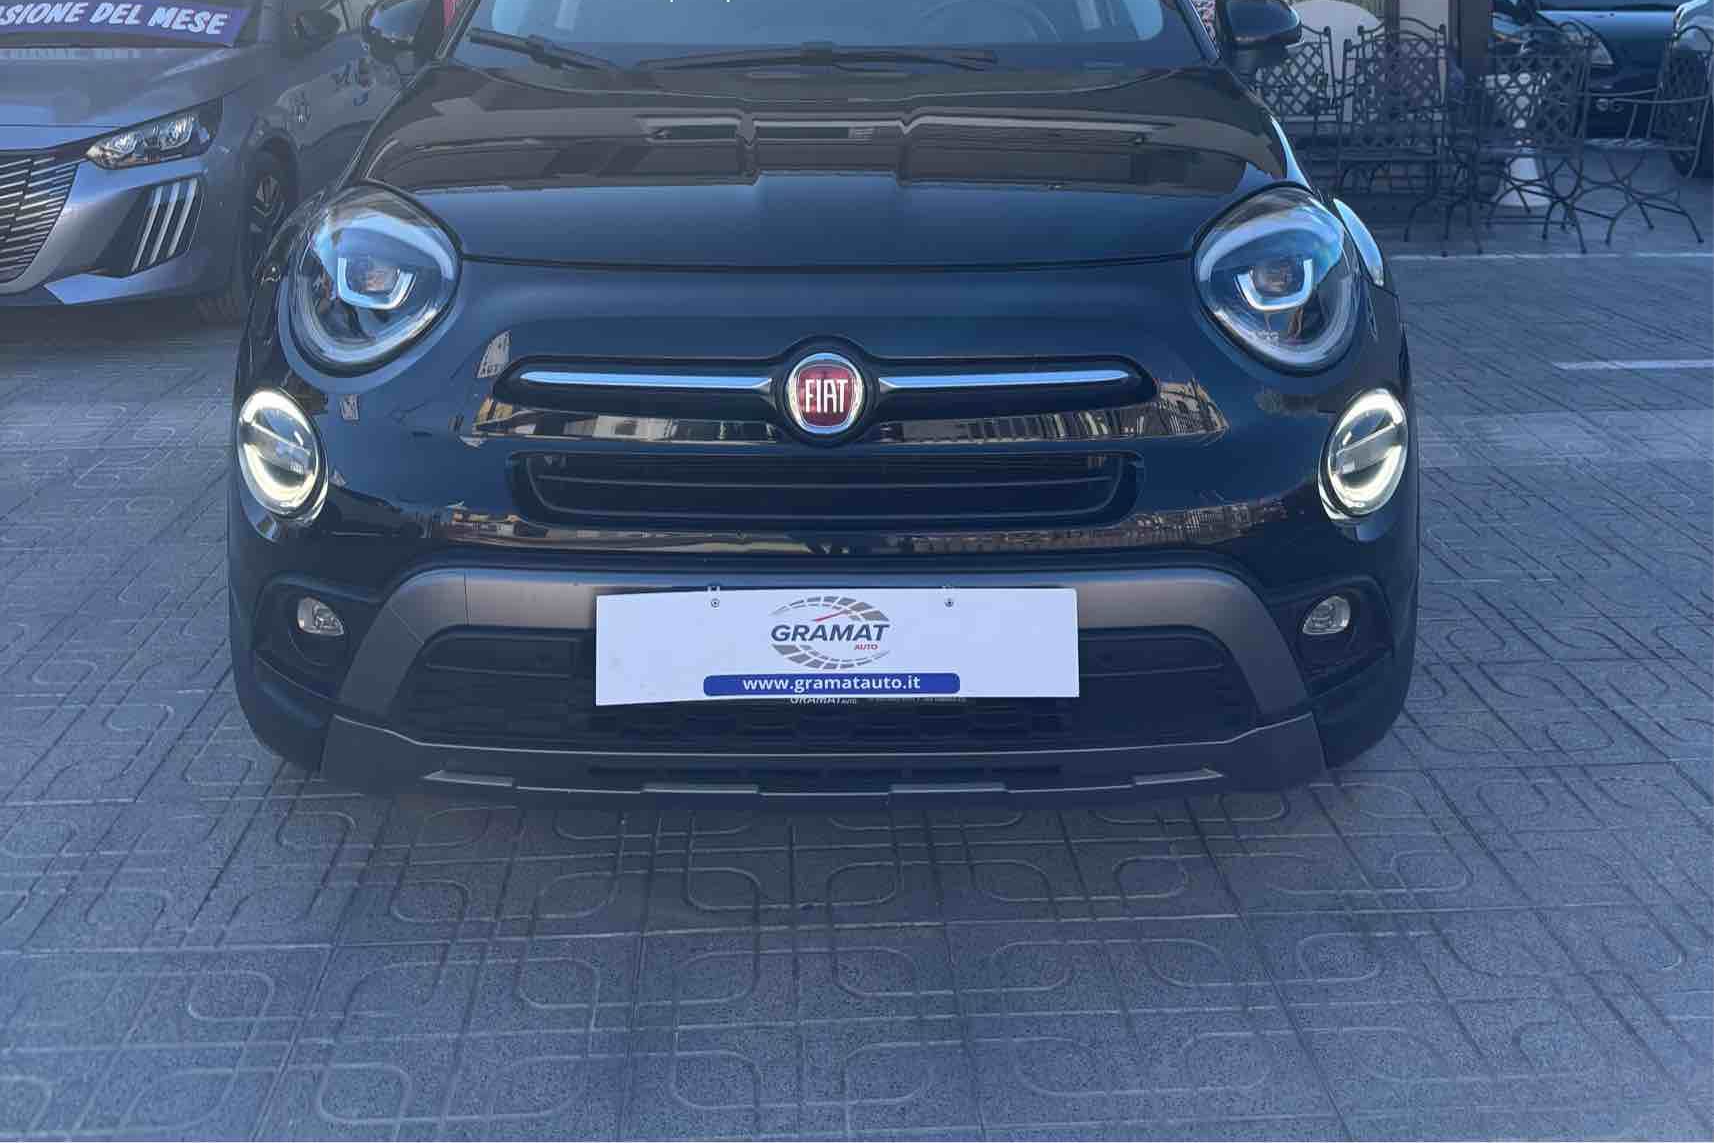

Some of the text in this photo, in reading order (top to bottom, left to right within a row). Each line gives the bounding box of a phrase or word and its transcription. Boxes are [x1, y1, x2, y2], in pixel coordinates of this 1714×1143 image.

[90, 2, 144, 26] DEL
[147, 6, 228, 35] MESE
[805, 379, 849, 413] FIAT
[771, 624, 890, 642] GRAMAT
[854, 642, 879, 651] AUTO
[743, 675, 921, 694] www.gramatauto.it
